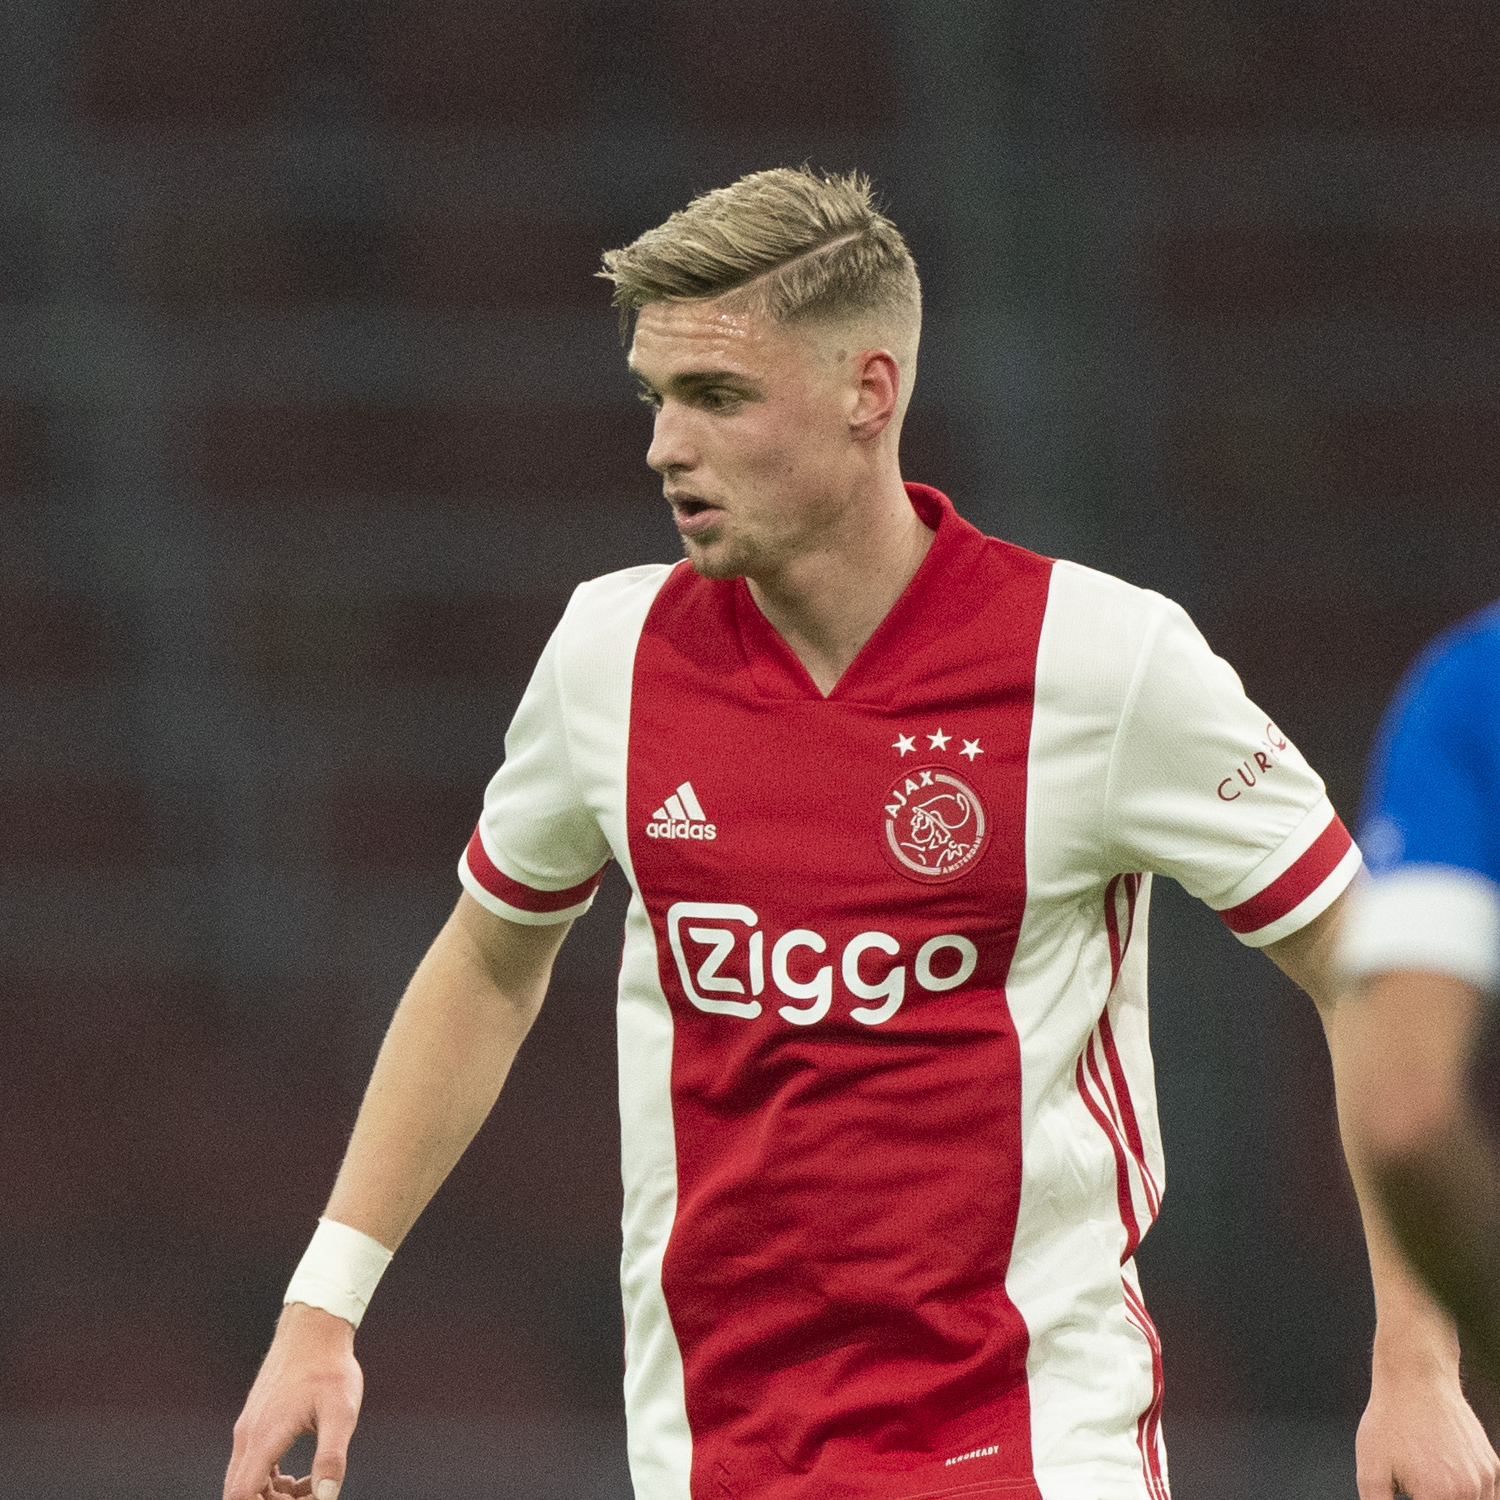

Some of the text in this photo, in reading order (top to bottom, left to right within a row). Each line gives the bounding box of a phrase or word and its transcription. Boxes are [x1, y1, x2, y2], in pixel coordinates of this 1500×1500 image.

[884, 770, 934, 818] AJAX
[646, 818, 717, 840] adidas
[668, 902, 978, 1025] Ziggo
